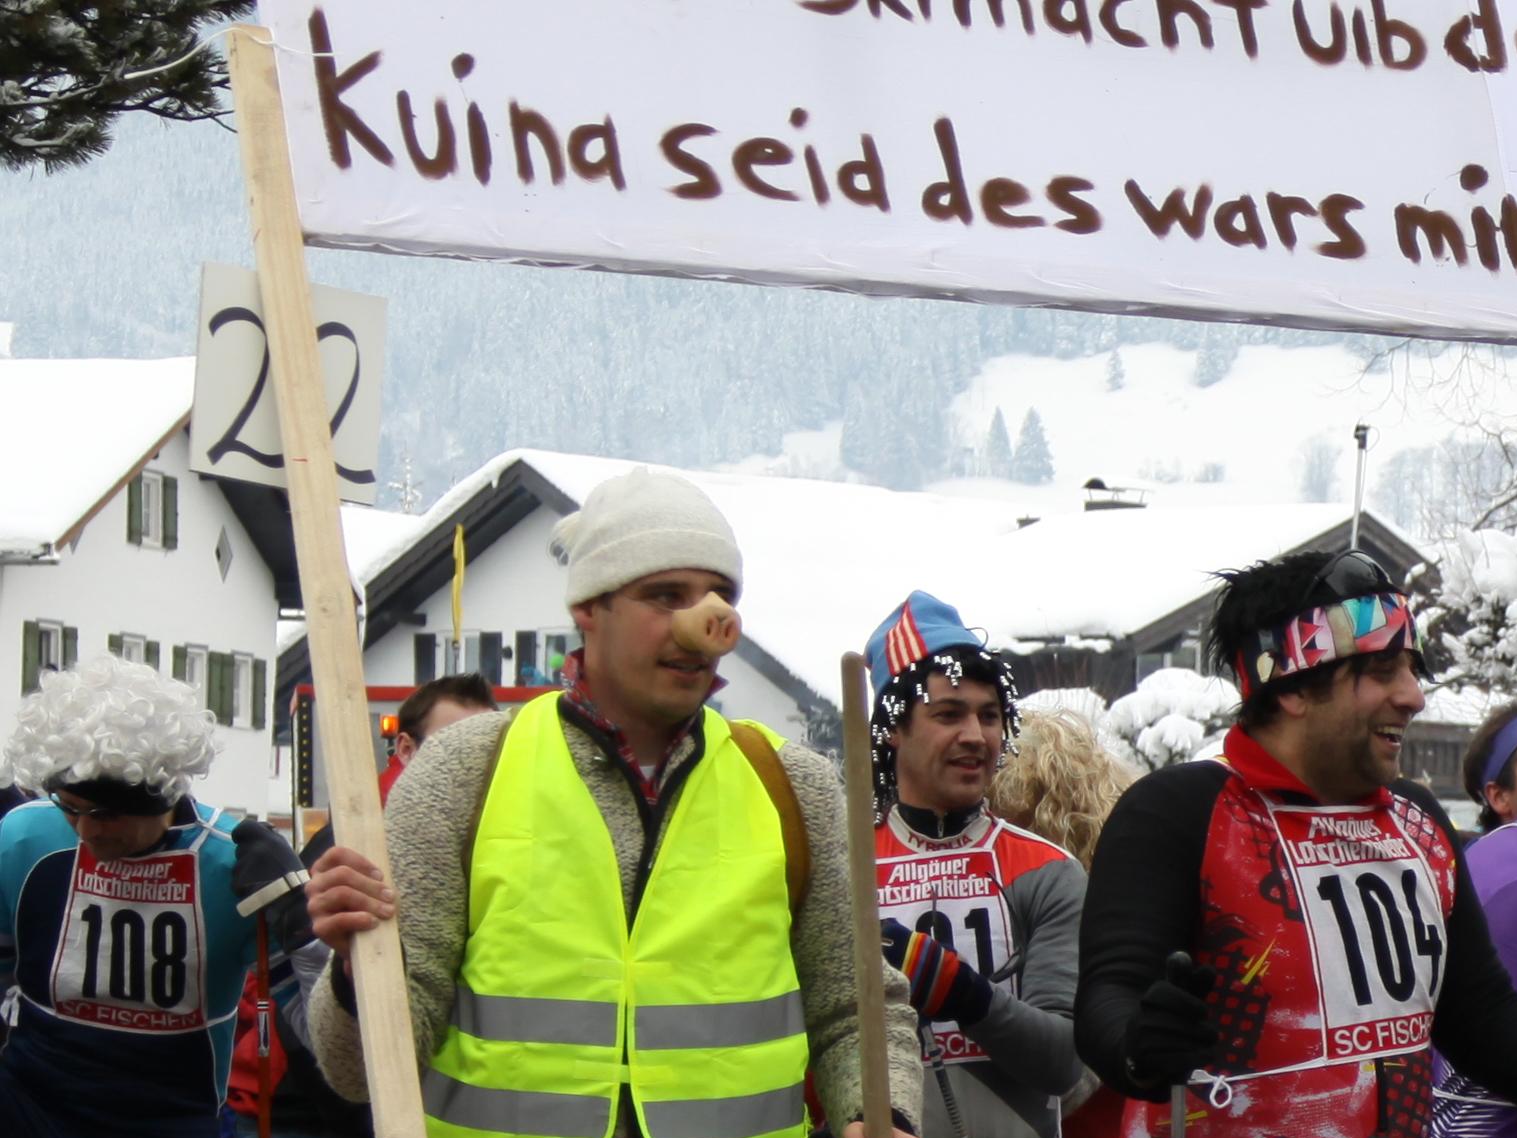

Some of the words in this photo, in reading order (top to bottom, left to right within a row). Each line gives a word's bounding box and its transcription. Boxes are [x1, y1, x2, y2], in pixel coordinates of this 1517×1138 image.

[659, 107, 891, 213] seid
[921, 117, 1103, 235] des
[1124, 179, 1367, 261] wars
[78, 868, 191, 902] Latschenkiefer
[888, 857, 970, 884] Allgäuer
[81, 903, 188, 1009] 108
[1317, 868, 1443, 1006] 104
[1334, 1025, 1374, 1056] SC
[1375, 1013, 1434, 1048] FISCH
